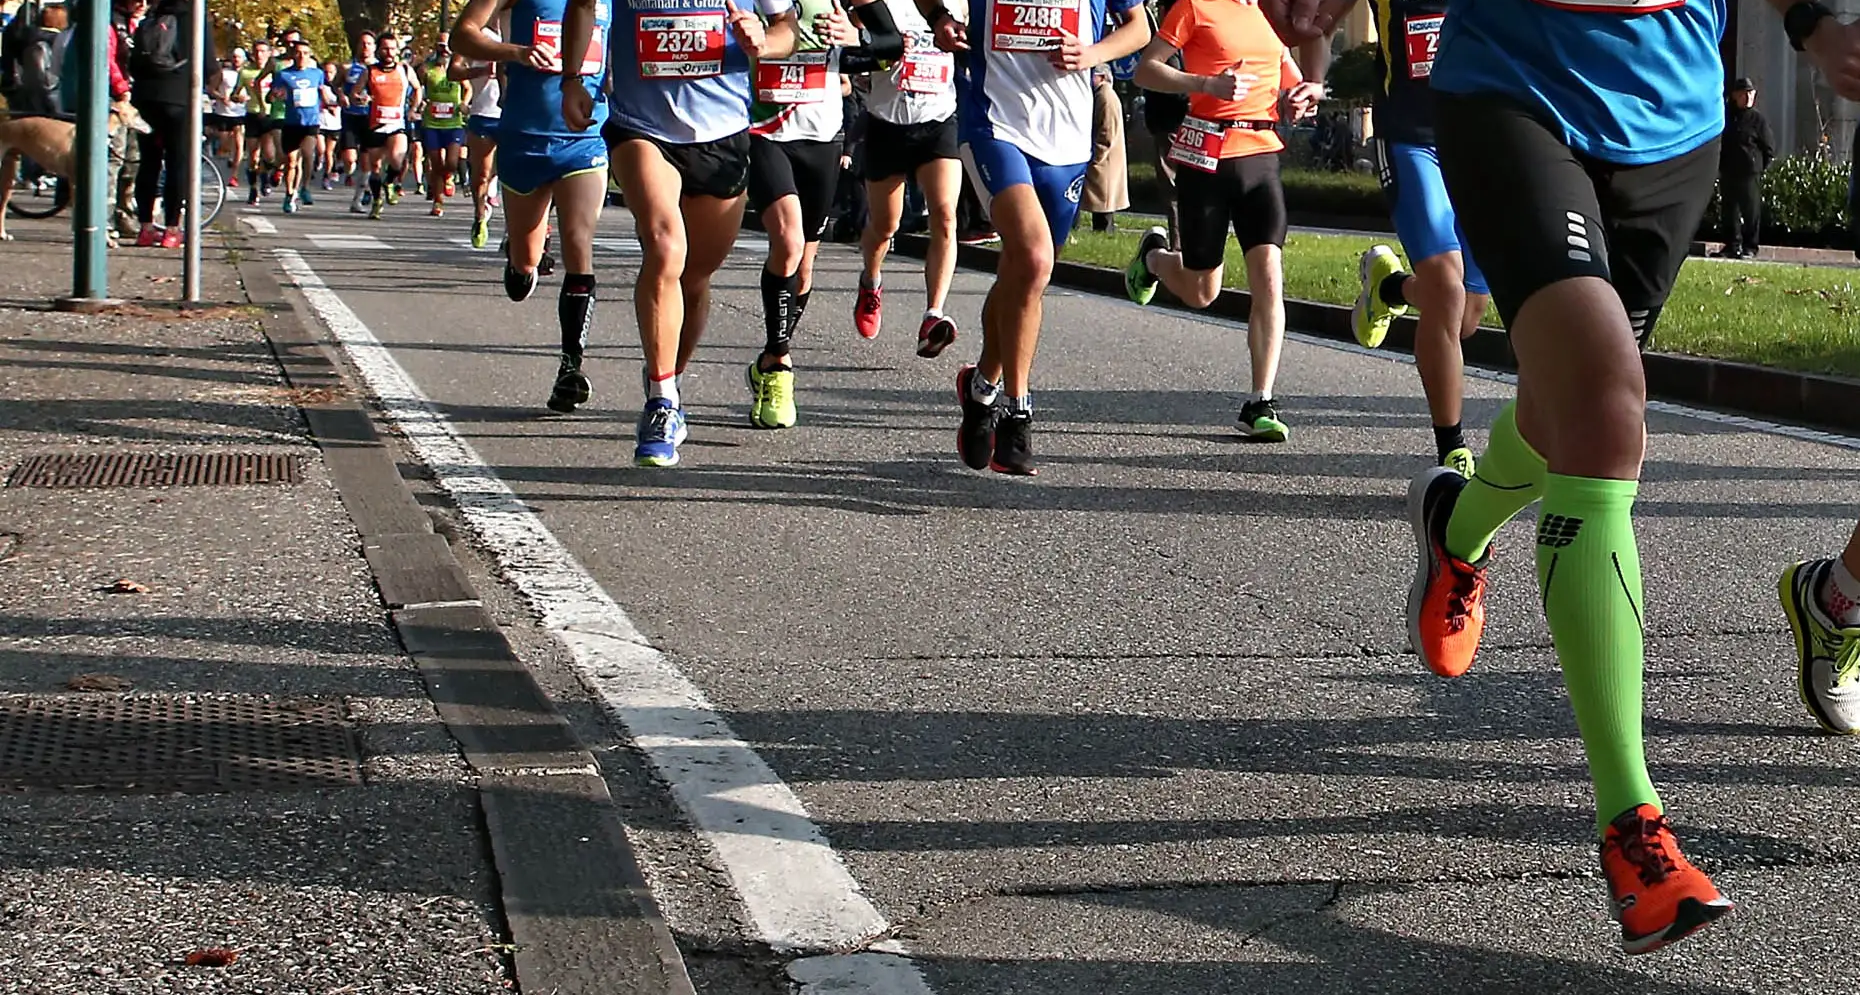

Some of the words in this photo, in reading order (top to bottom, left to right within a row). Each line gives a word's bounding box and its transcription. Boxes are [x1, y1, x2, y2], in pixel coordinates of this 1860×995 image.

[1013, 6, 1062, 28] 2488
[656, 31, 707, 52] 2326
[780, 65, 805, 83] 741
[1178, 127, 1205, 147] 296
